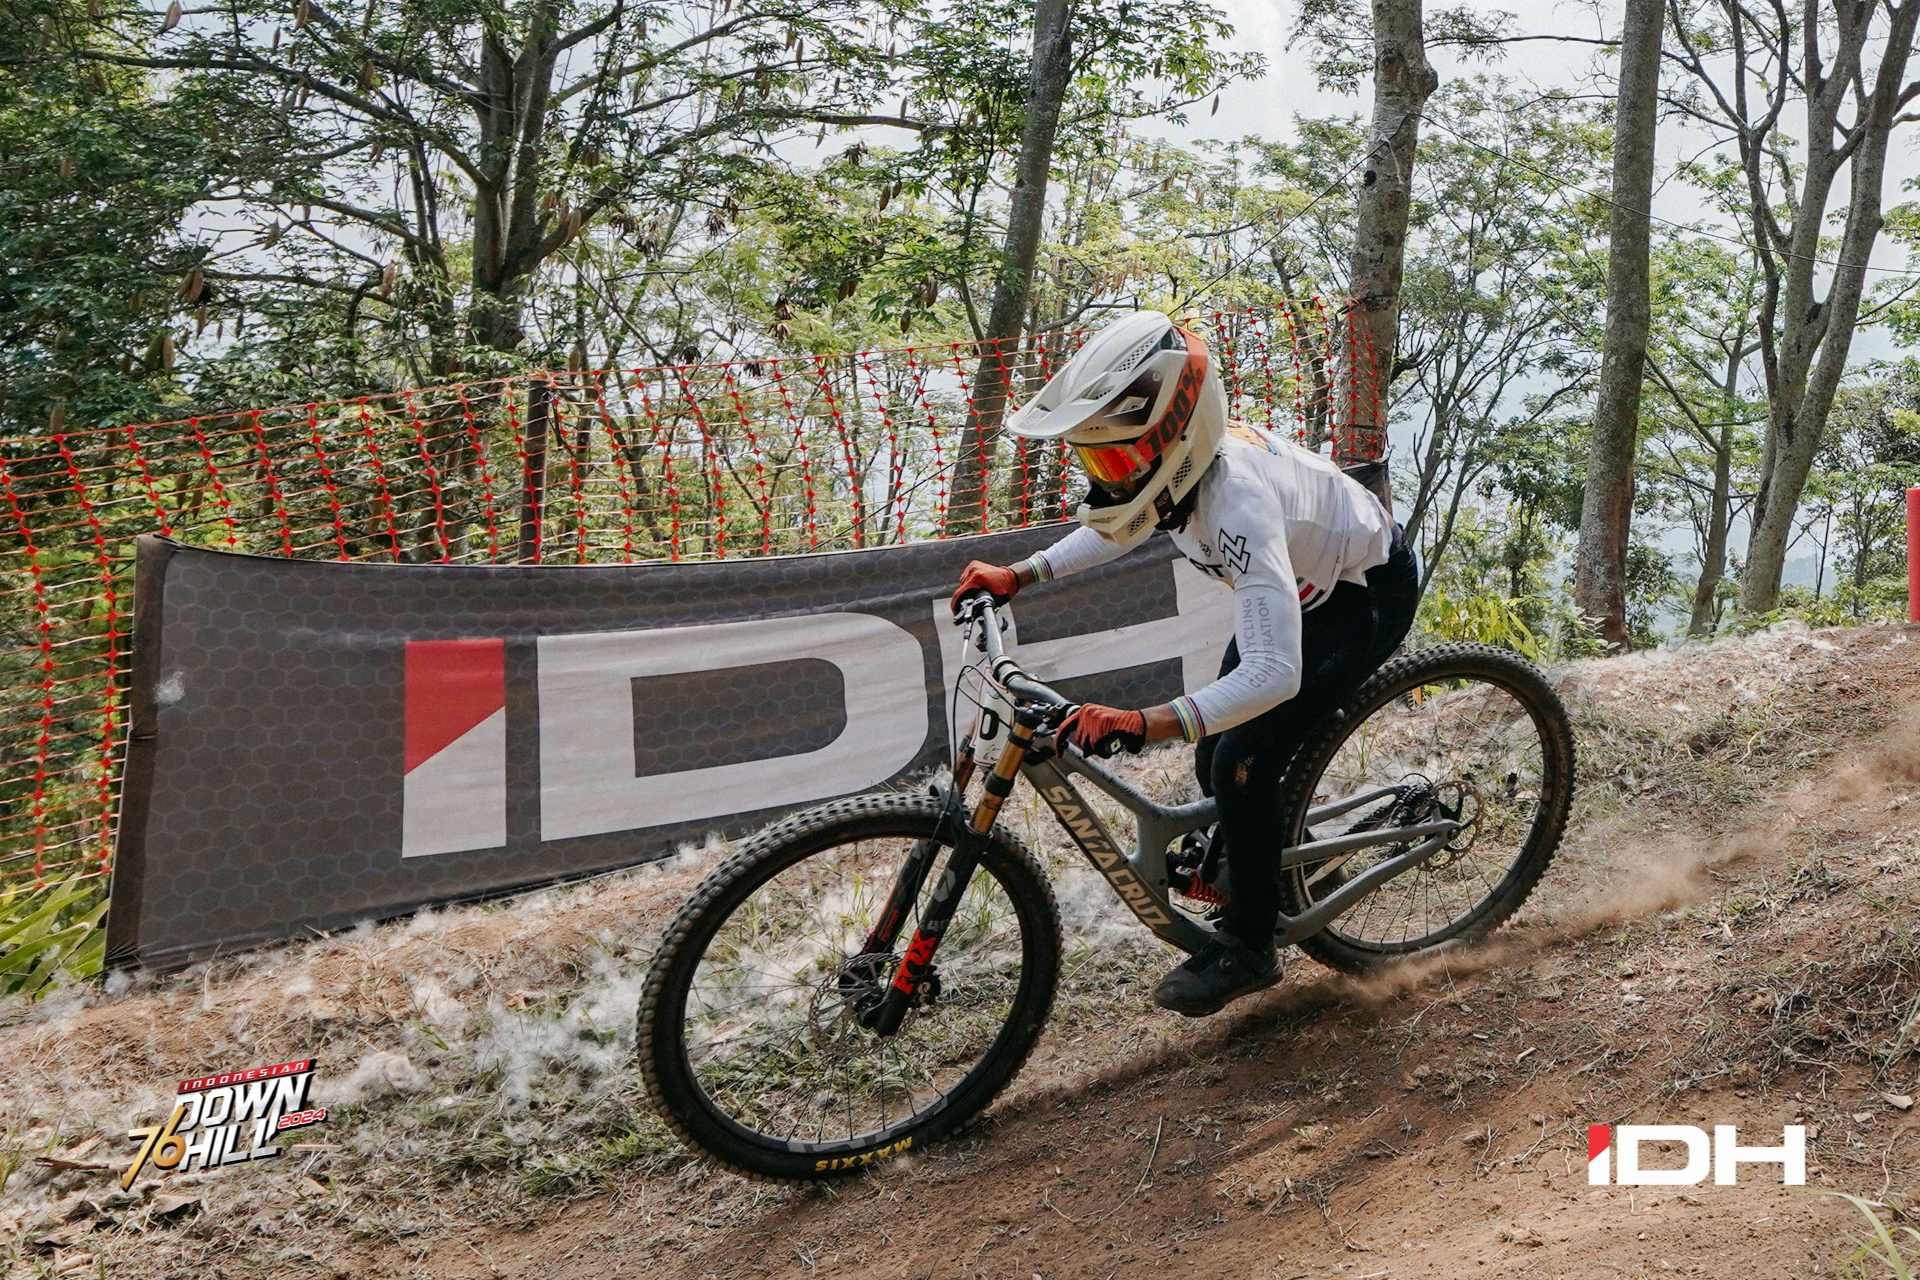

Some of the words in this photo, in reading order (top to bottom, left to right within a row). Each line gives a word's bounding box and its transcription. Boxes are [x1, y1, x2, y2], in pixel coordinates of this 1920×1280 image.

[1144, 360, 1204, 457] 100%
[1242, 598, 1257, 653] YCLING
[1249, 596, 1278, 689] CONDERATION
[402, 556, 1237, 858] IDH
[1041, 785, 1119, 870] SANTA
[1107, 868, 1172, 930] CRUZ
[892, 928, 937, 994] FOX
[815, 1136, 913, 1171] MAXXIS
